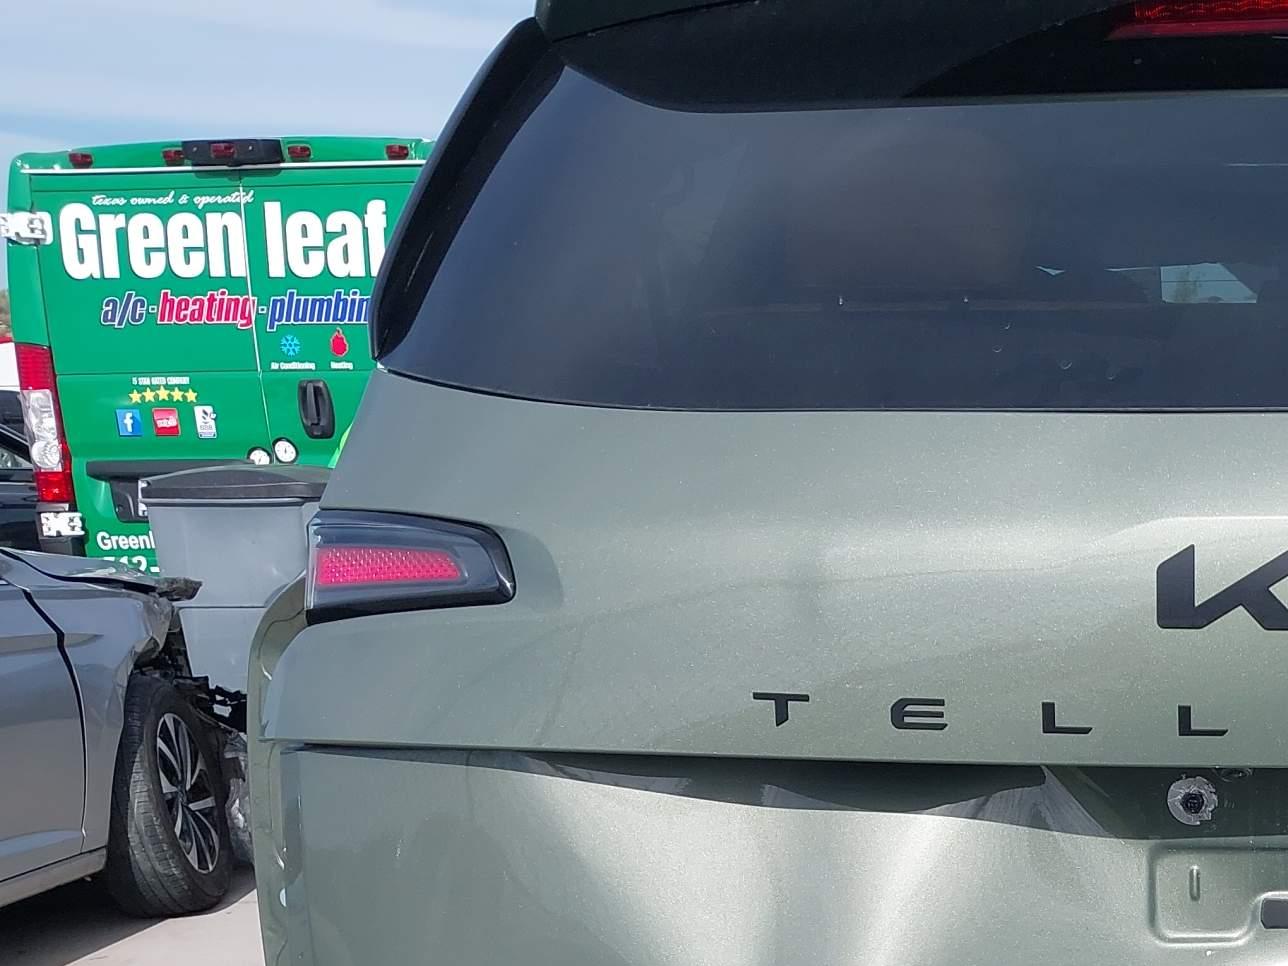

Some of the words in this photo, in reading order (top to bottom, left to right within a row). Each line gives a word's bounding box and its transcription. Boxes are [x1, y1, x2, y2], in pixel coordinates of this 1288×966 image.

[92, 193, 128, 206] texas
[130, 190, 176, 205] owned
[178, 193, 190, 205] &
[193, 190, 255, 210] operated
[59, 202, 247, 280] Green
[263, 199, 388, 278] leaf
